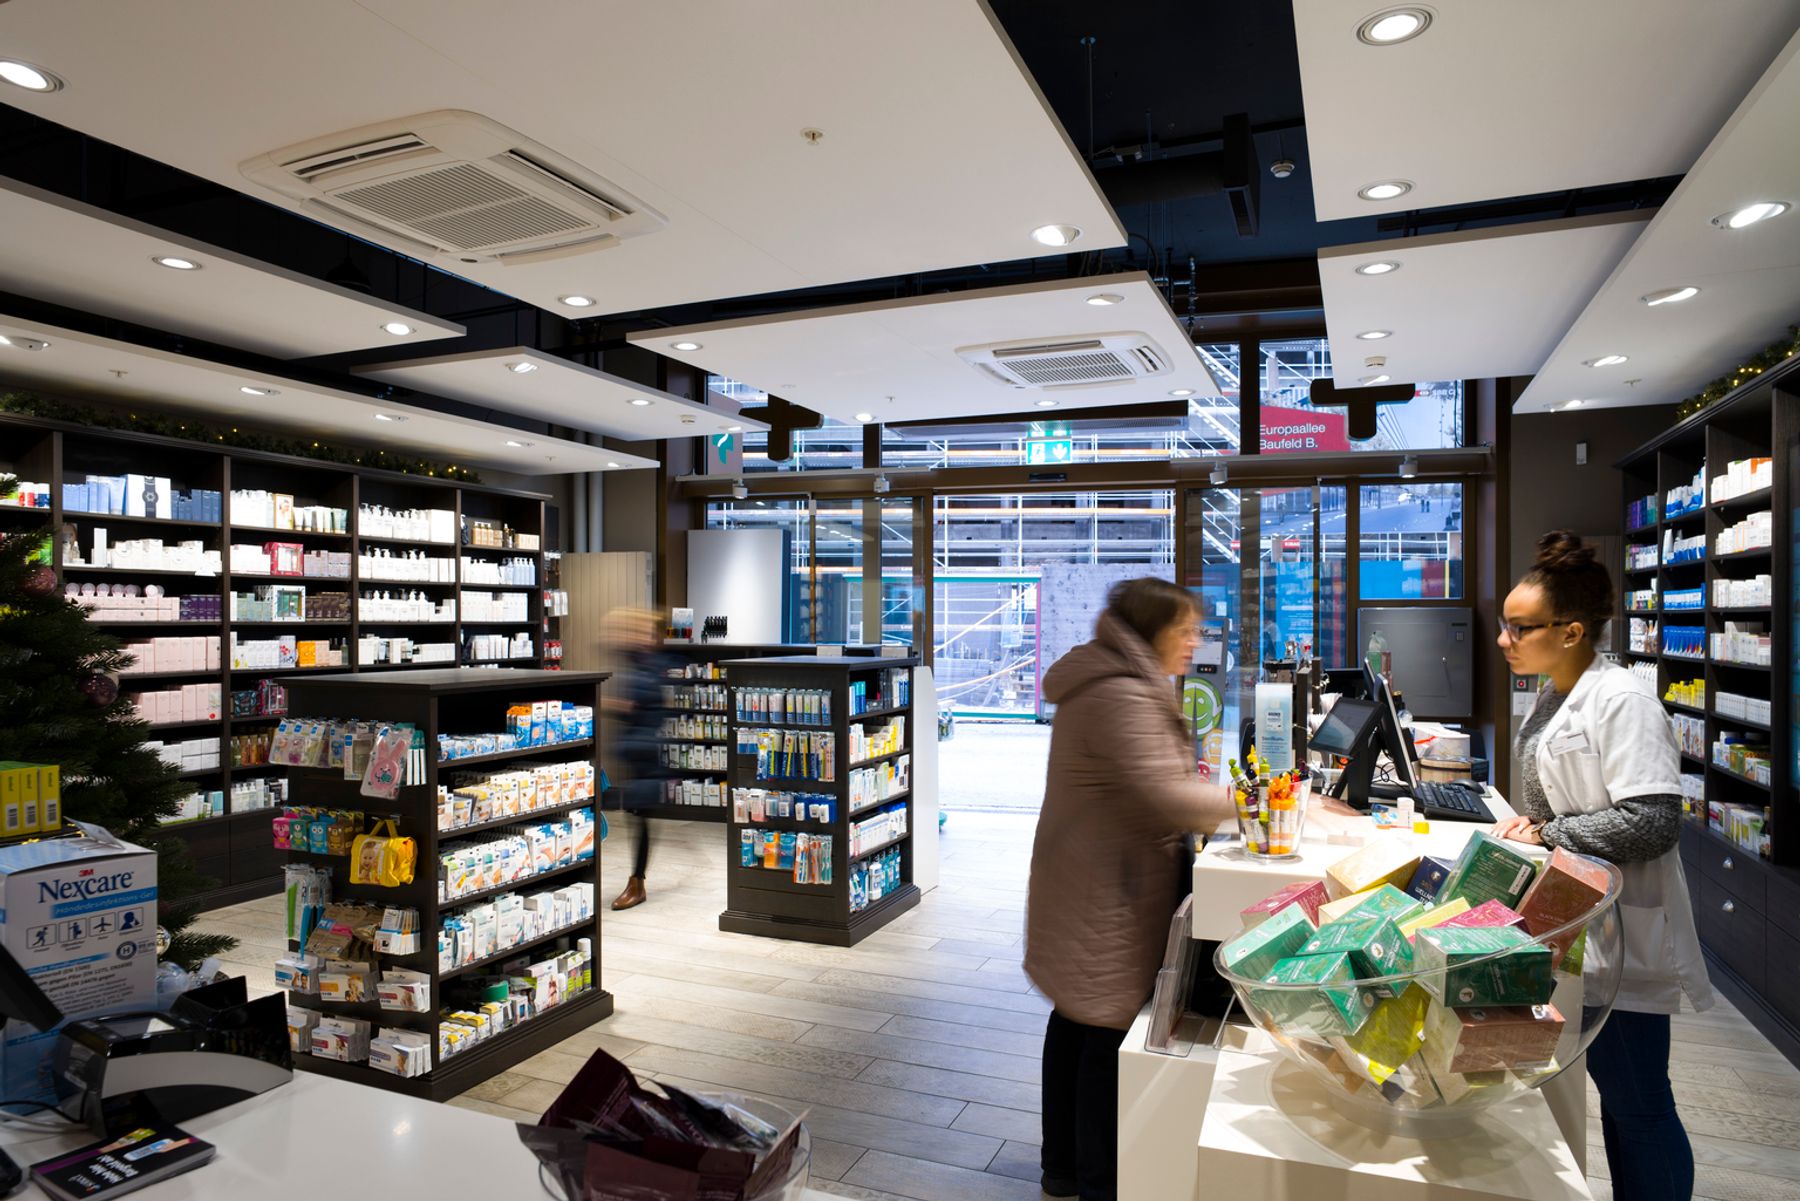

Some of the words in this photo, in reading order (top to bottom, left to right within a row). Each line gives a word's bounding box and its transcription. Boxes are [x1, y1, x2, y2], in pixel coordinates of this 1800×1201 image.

[1259, 423, 1326, 436] Europaallee
[1259, 438, 1302, 450] Baufeld
[1305, 437, 1319, 448] B.
[78, 868, 95, 877] 3M
[38, 872, 134, 904] Nexcare
